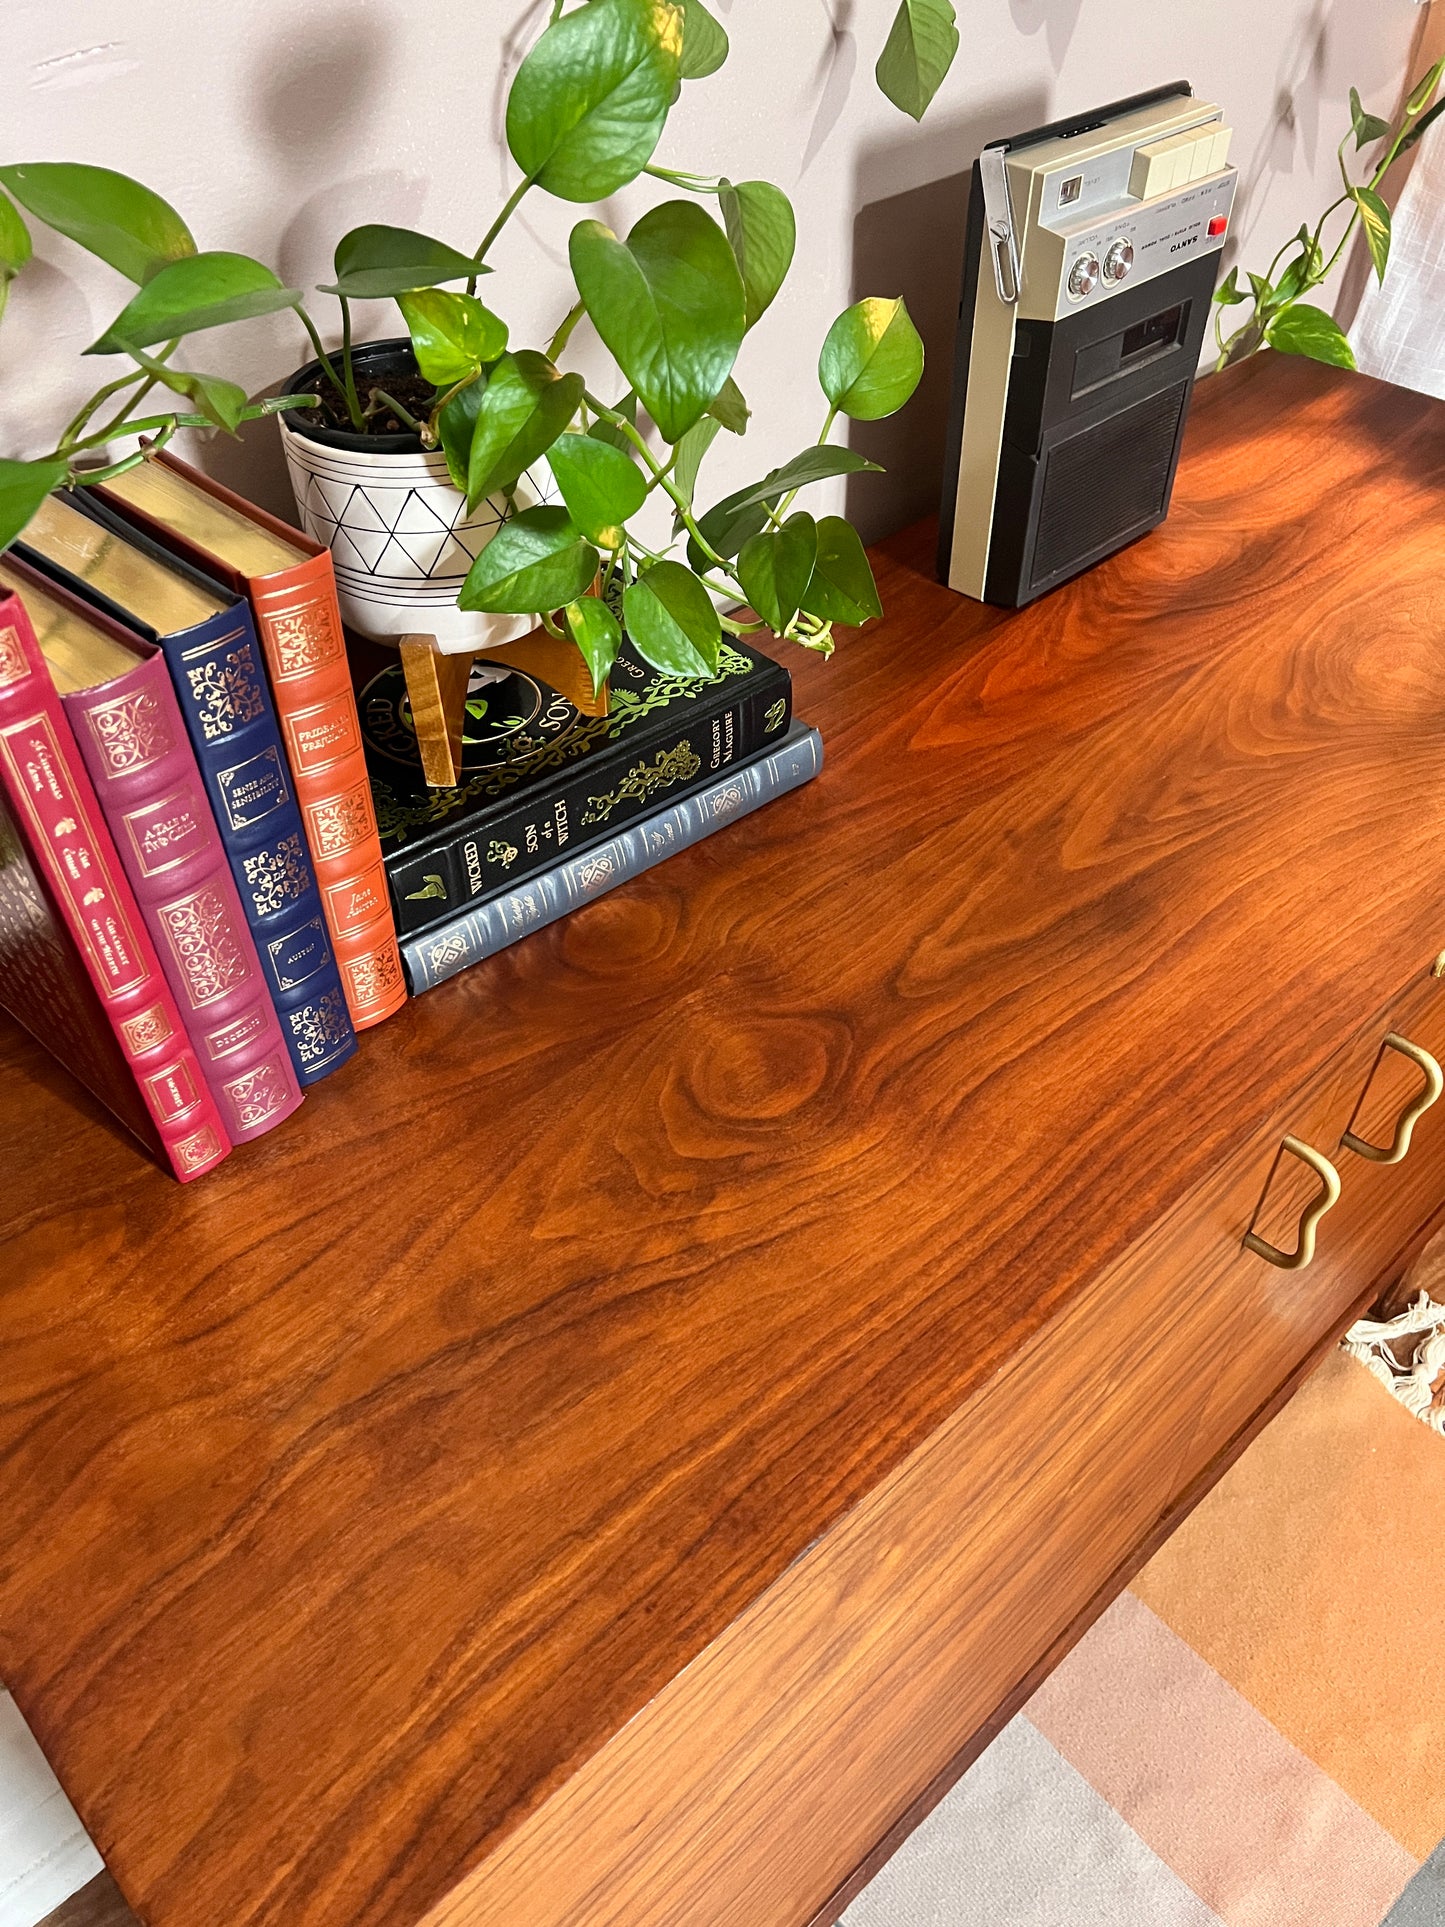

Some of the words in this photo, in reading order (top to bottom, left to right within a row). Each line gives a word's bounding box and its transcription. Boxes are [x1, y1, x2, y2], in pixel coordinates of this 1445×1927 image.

[1170, 235, 1198, 253] SANYO
[615, 655, 645, 679] GREG
[366, 698, 418, 753] CKED
[539, 692, 573, 731] SON
[298, 725, 330, 742] PRIDE
[710, 718, 721, 770] GREGORY
[723, 710, 733, 767] MAGUIRE
[231, 777, 280, 810] SENSIBILITY
[232, 780, 259, 798] SENSE
[144, 829, 156, 841] A
[152, 816, 180, 836] TALE
[524, 823, 539, 853] SON
[554, 799, 570, 847] WITCH
[464, 841, 484, 895] WICKED
